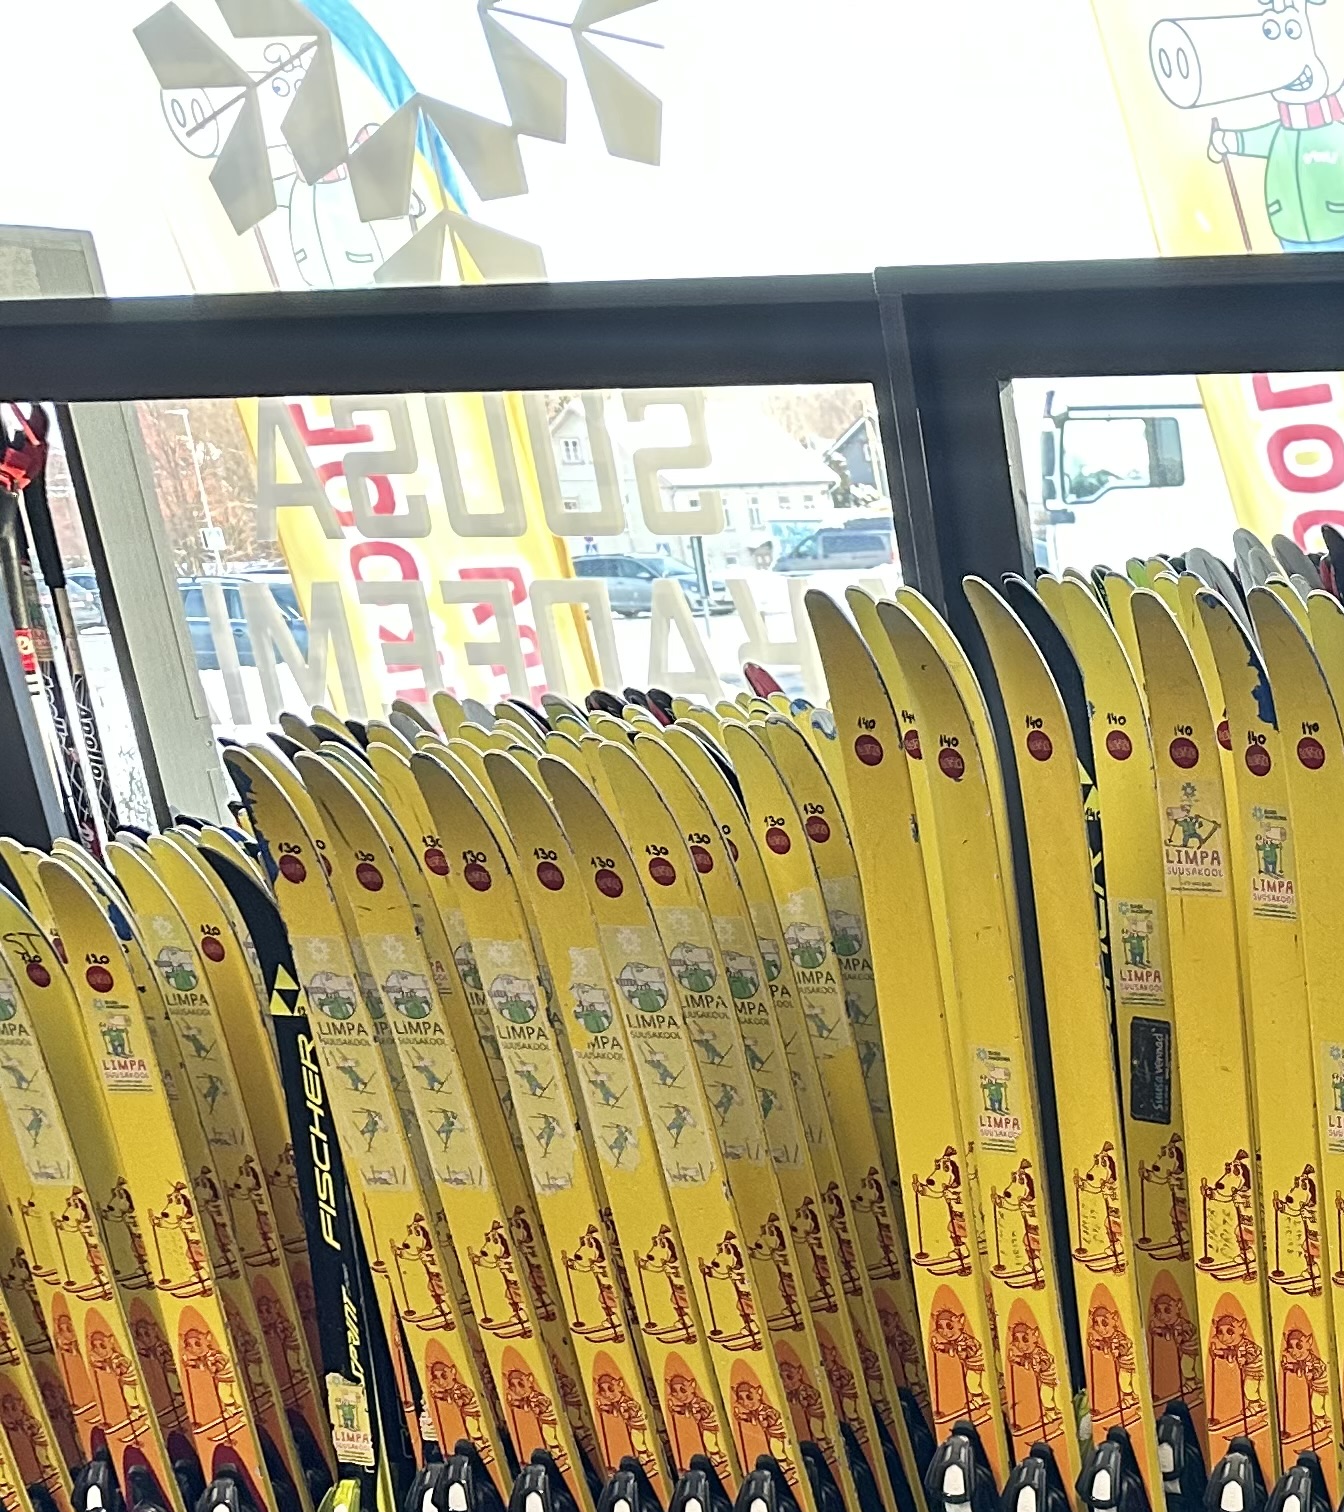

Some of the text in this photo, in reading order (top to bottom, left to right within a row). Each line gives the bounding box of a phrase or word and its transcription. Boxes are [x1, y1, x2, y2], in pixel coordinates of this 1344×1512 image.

[857, 717, 877, 730] 140
[1025, 715, 1044, 729] 140
[1106, 713, 1127, 726] 140
[1174, 725, 1194, 737] 140
[939, 734, 960, 748] 140
[1247, 732, 1267, 746] 140
[803, 803, 825, 816] 130
[765, 815, 785, 828] 130
[278, 841, 302, 855] 130
[533, 847, 558, 862] 130
[645, 844, 669, 857] 130
[462, 850, 488, 865] 130
[1164, 848, 1222, 868] LIMPA
[1252, 876, 1295, 895] LIMPA
[1119, 967, 1163, 984] LIMPA
[317, 1021, 369, 1038] LIMPA
[393, 1020, 445, 1036] LIMPA
[626, 1013, 680, 1031] LIMPA
[498, 1024, 550, 1042] LIMPA
[979, 1114, 1022, 1132] LIMPA
[297, 1032, 343, 1251] FISCHER
